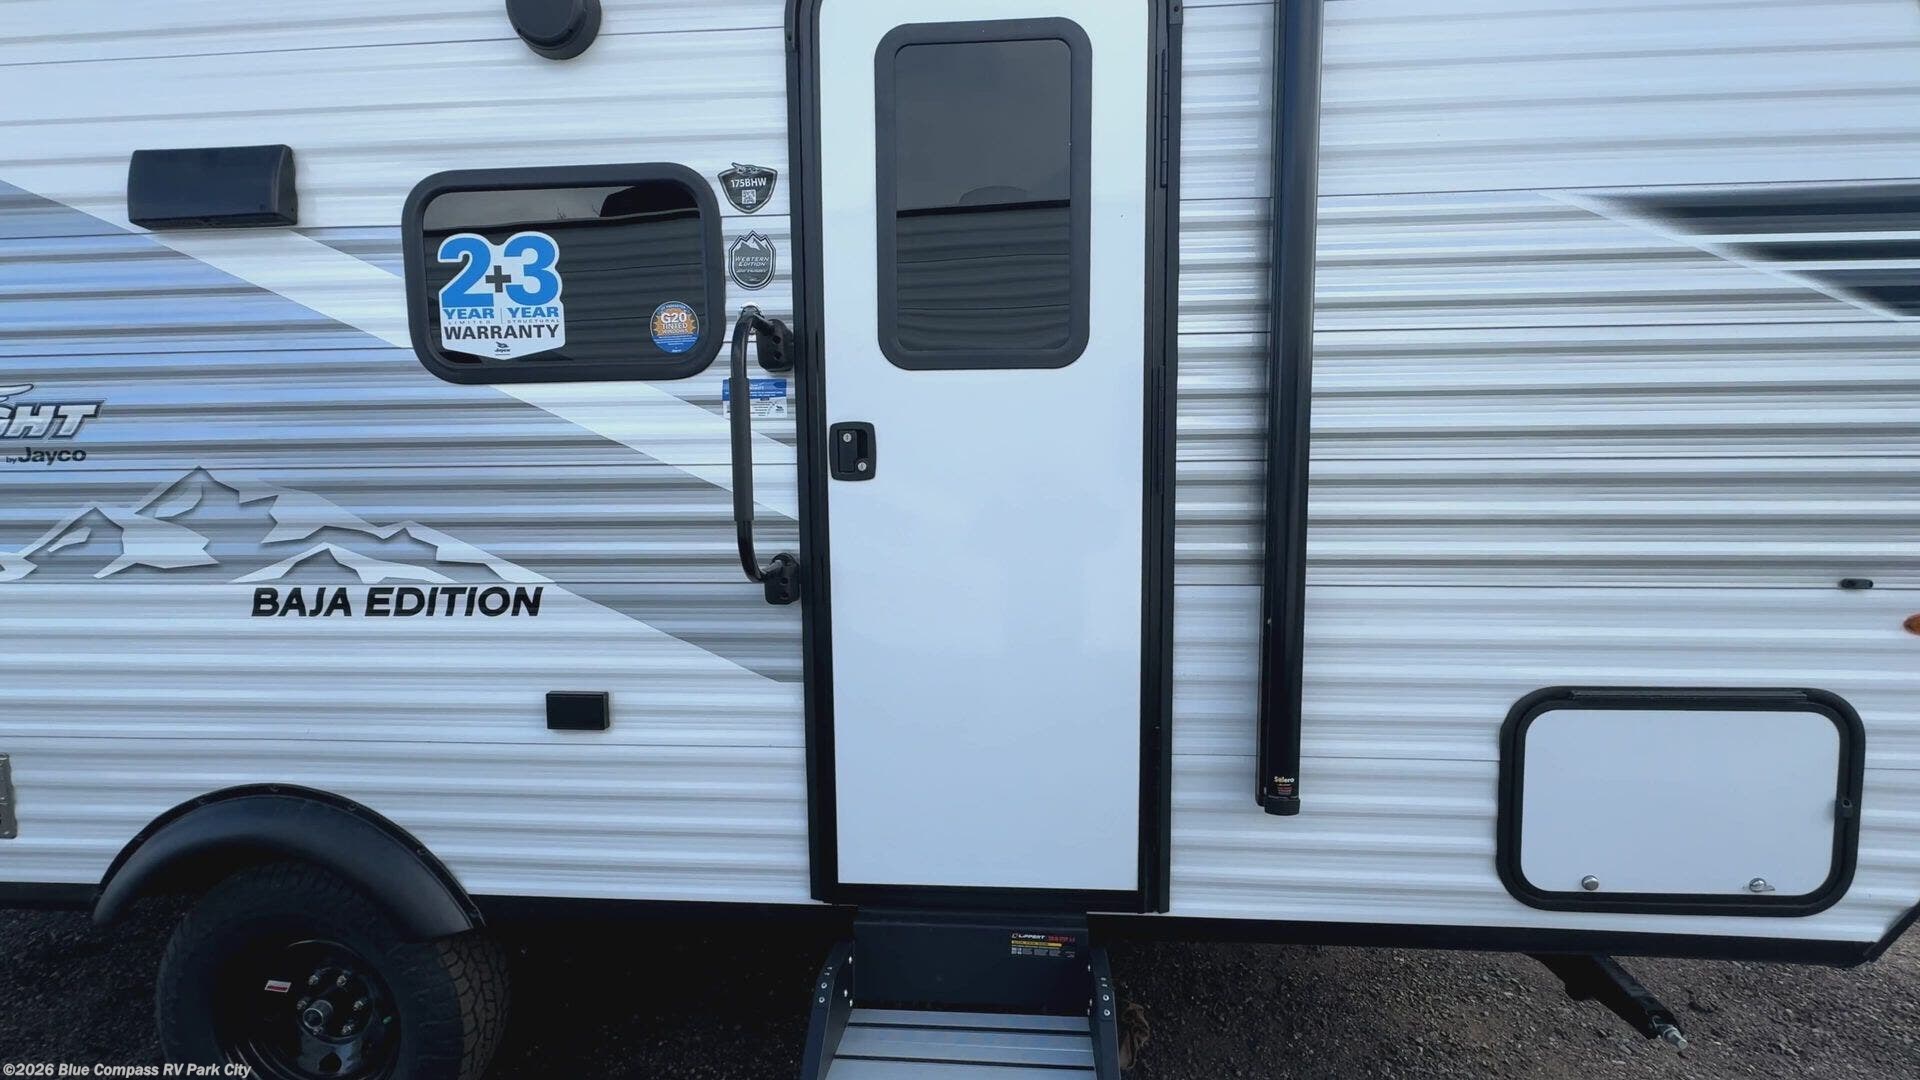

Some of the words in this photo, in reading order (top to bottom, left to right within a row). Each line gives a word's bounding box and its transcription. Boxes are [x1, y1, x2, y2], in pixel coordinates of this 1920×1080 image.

[730, 177, 767, 189] 175BHW
[442, 308, 494, 319] YEAR
[507, 306, 560, 318] YEAR
[660, 312, 687, 324] G20
[443, 324, 560, 340] WARRANTY
[6, 456, 18, 464] by
[18, 446, 87, 465] Jayco
[251, 587, 352, 617] BAJA
[364, 586, 544, 617] EDITION
